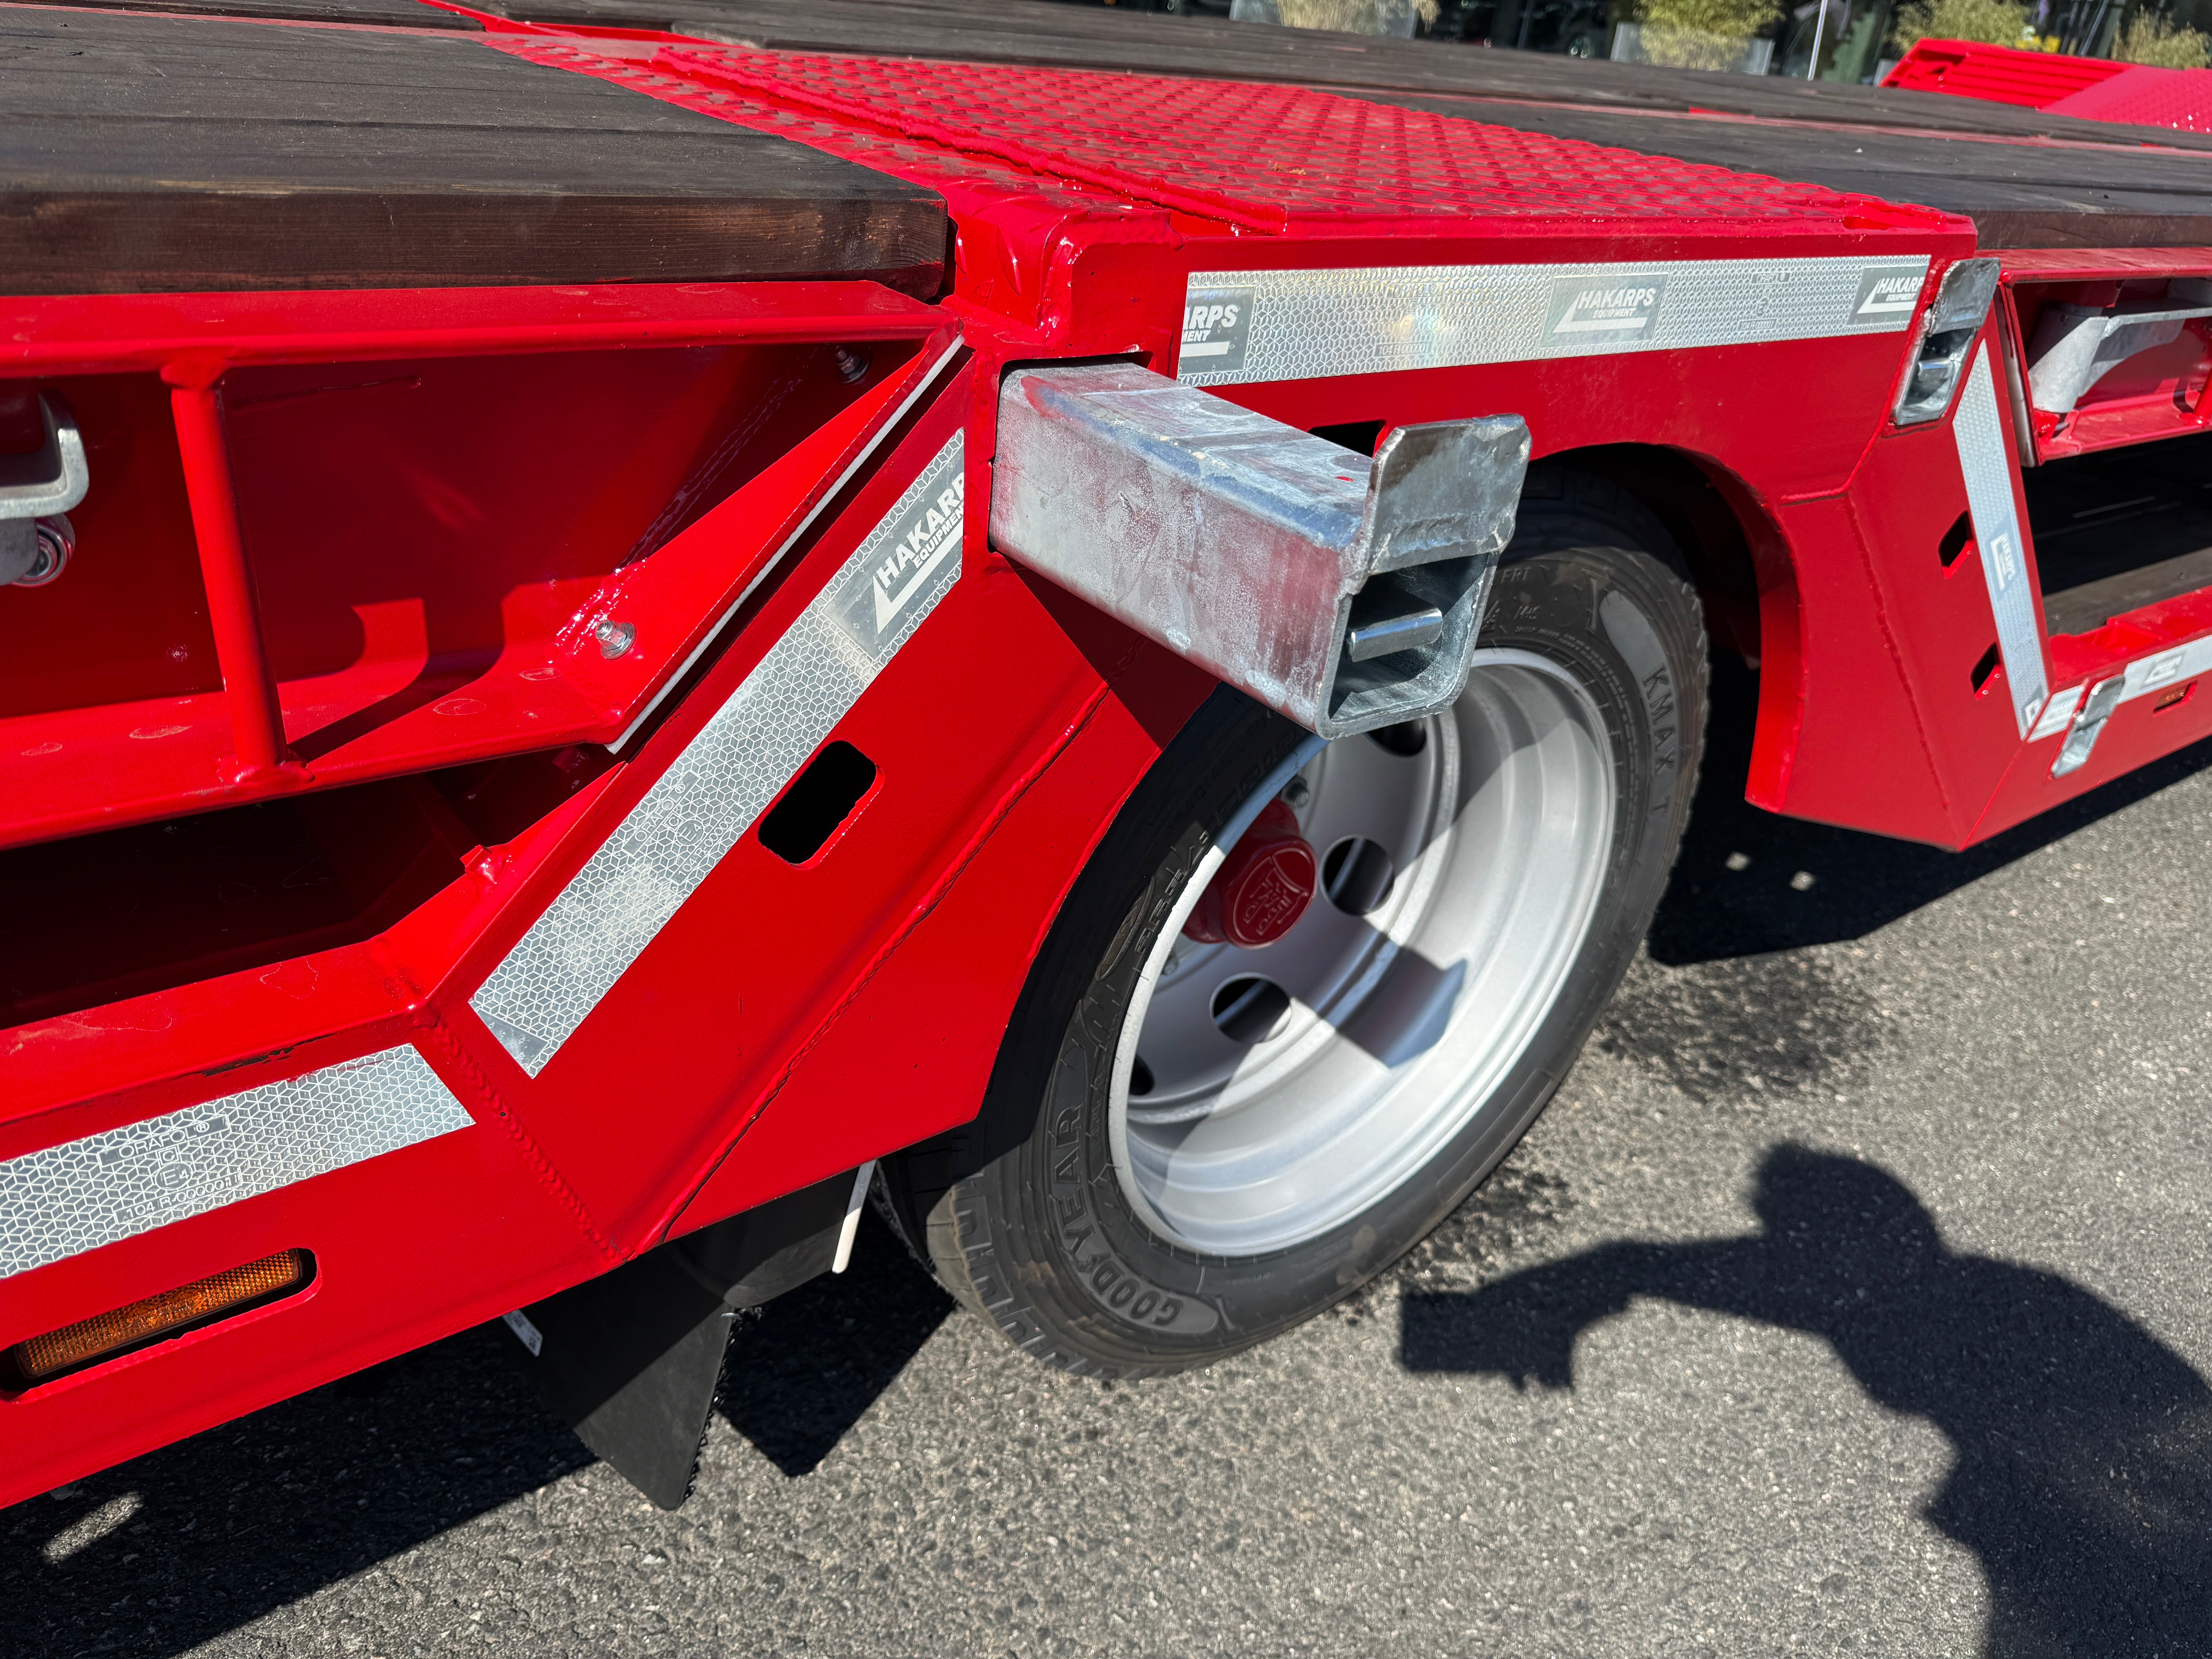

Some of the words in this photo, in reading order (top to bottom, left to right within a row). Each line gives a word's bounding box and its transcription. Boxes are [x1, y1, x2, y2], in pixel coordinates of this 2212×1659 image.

[1577, 288, 1656, 309] HAKARPS
[1593, 307, 1637, 319] EQUIPMENT
[1886, 293, 1916, 302] EQUIPMENT
[913, 500, 963, 568] EQUIPMEN
[1642, 663, 1675, 775] KMAX
[1054, 1103, 1183, 1326] GOODYEAR
